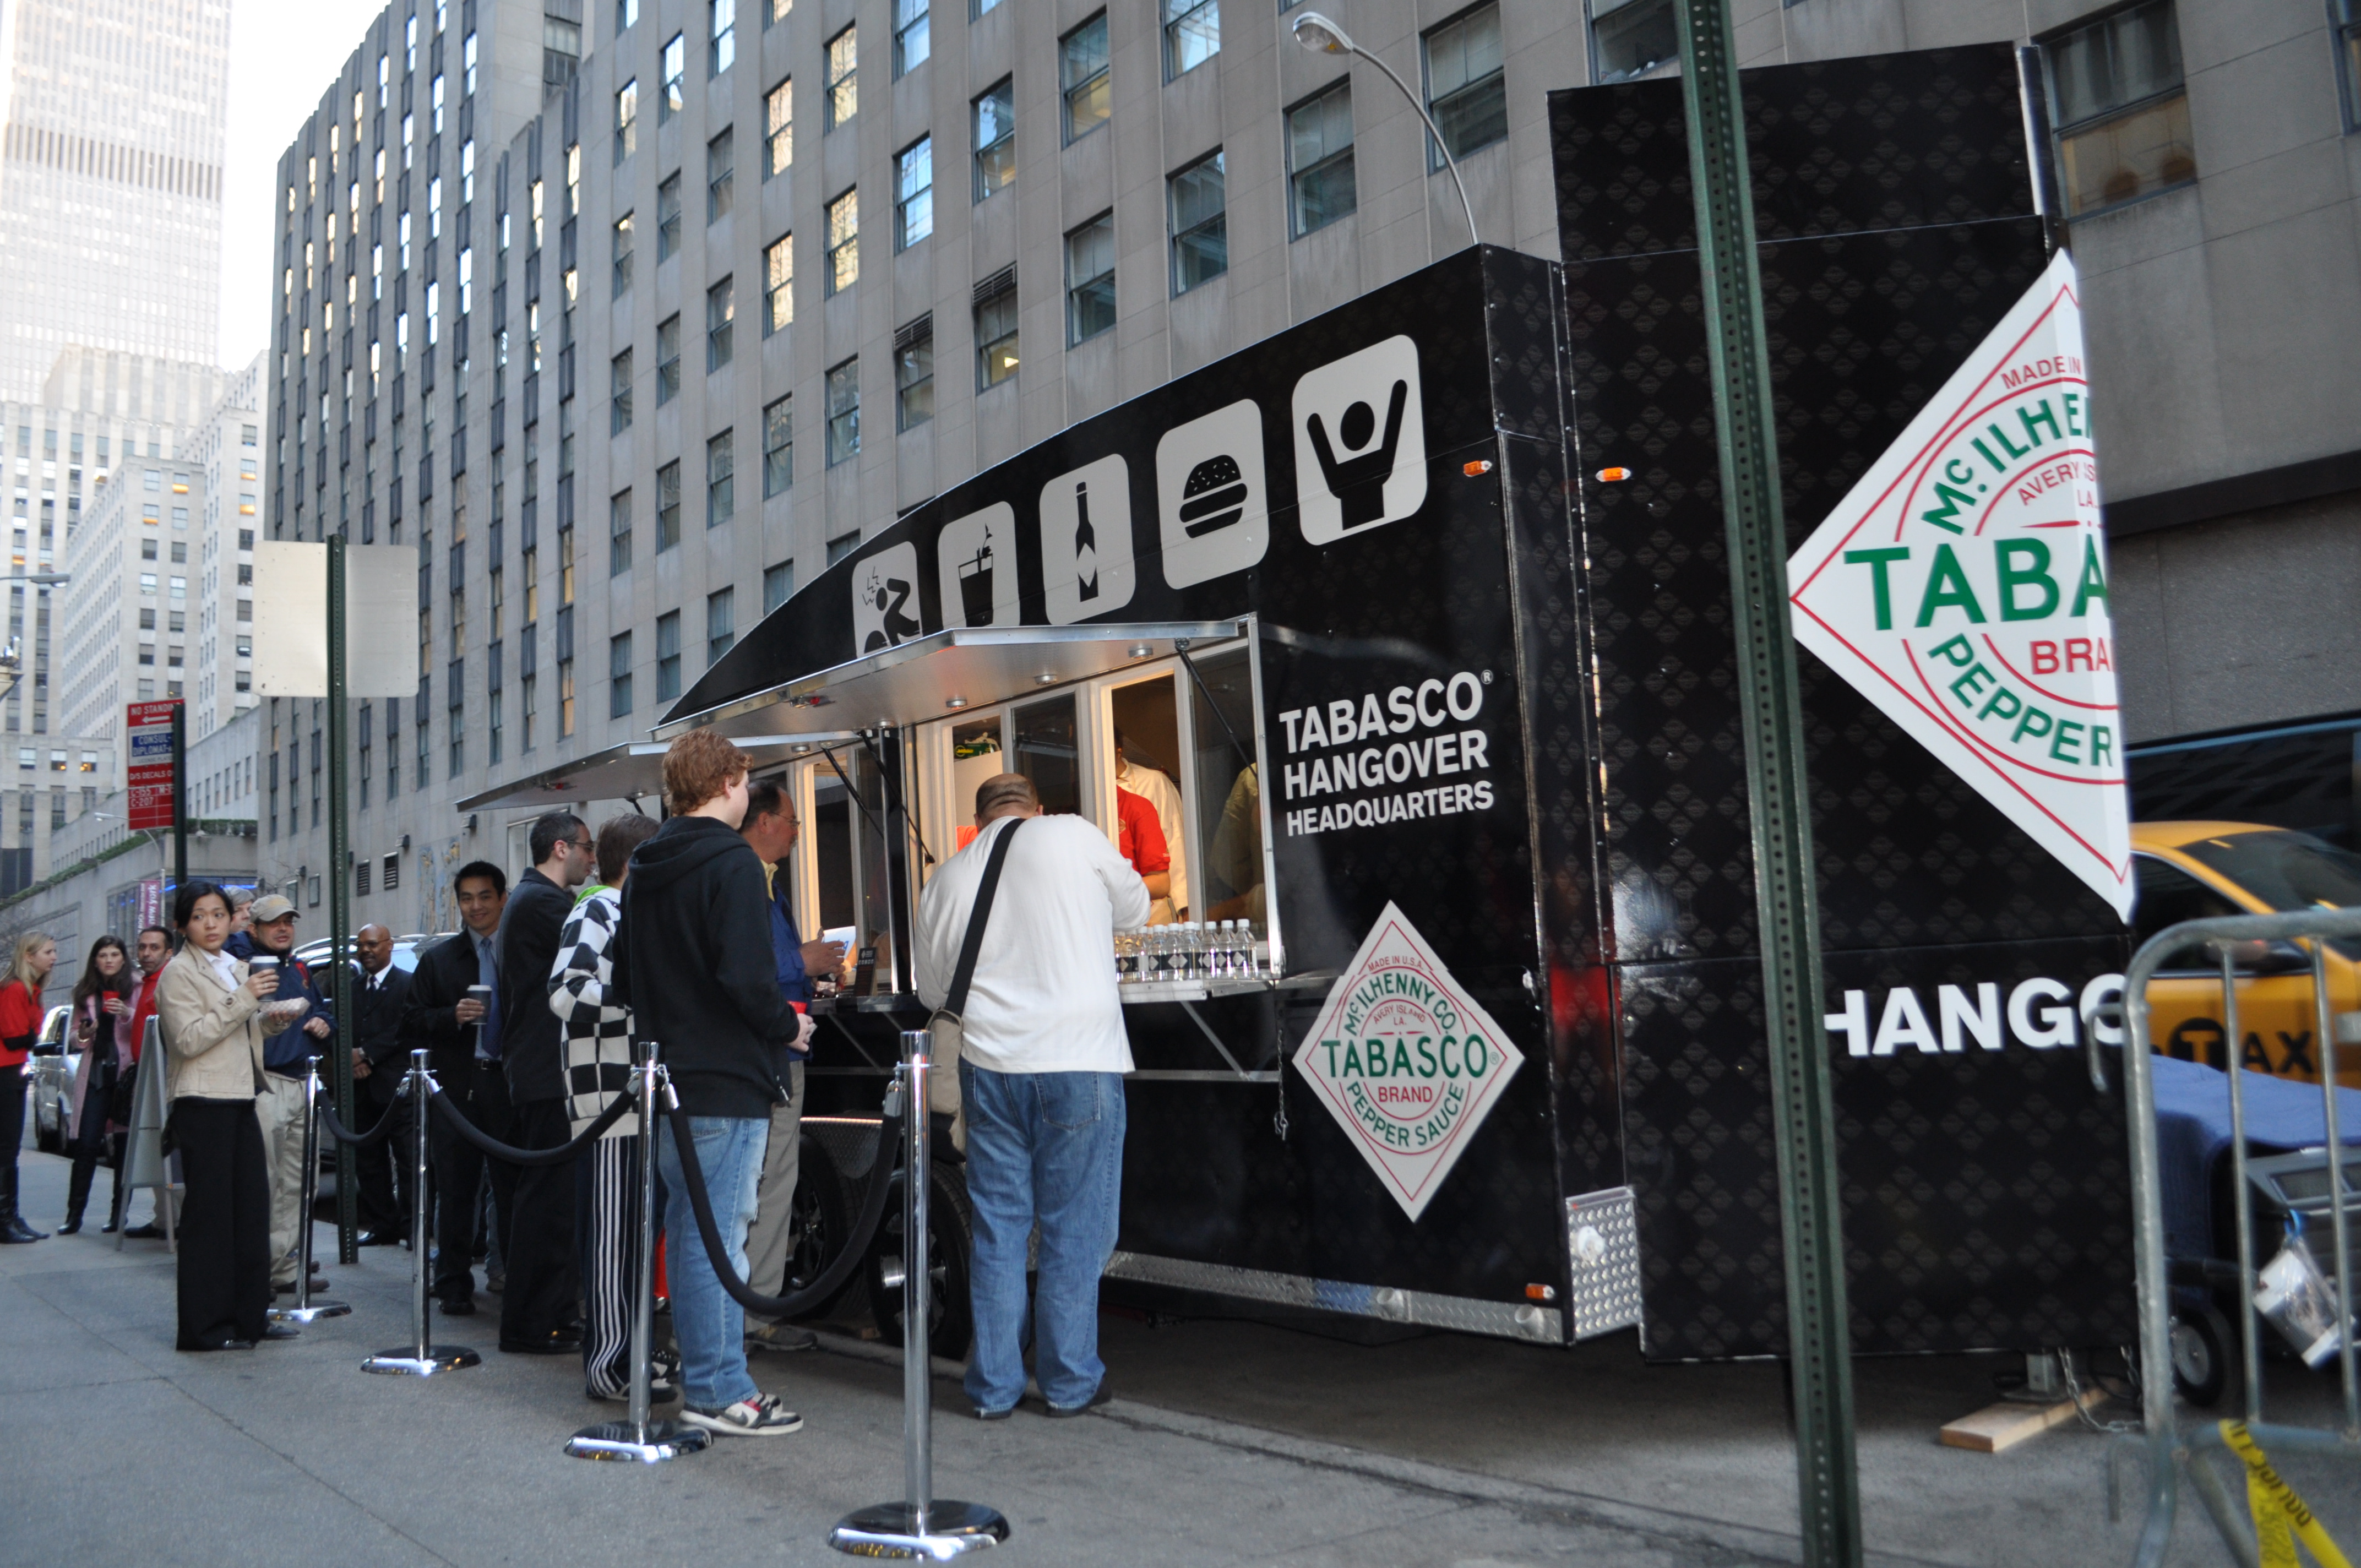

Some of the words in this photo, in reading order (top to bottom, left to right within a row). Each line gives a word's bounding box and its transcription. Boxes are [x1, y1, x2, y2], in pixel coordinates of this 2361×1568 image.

[2000, 356, 2065, 389] MADE
[2068, 356, 2082, 375] IN
[2018, 461, 2079, 506] AVERY
[131, 706, 142, 716] NO
[144, 703, 176, 715] STANDIN
[1927, 633, 2114, 767] PEPPER
[142, 770, 166, 779] DECALS
[1284, 729, 1489, 800] HANGOVER
[130, 797, 154, 808] C-207
[1287, 780, 1494, 836] HEADQUARTERS
[146, 884, 158, 905] york
[148, 905, 156, 924] new
[1367, 956, 1390, 972] MADE
[1391, 955, 1400, 964] IN
[1402, 956, 1423, 970] U.S.A.
[1373, 1004, 1394, 1024] AVERY
[1396, 1004, 1426, 1023] ISLAND
[1393, 1016, 1407, 1026] LA.
[1433, 999, 1456, 1035] CO.
[2179, 1027, 2314, 1073] TAX
[1378, 1086, 1433, 1103] BRAND
[1346, 1080, 1410, 1147] PEPPER
[1415, 1081, 1464, 1146] SAUCE
